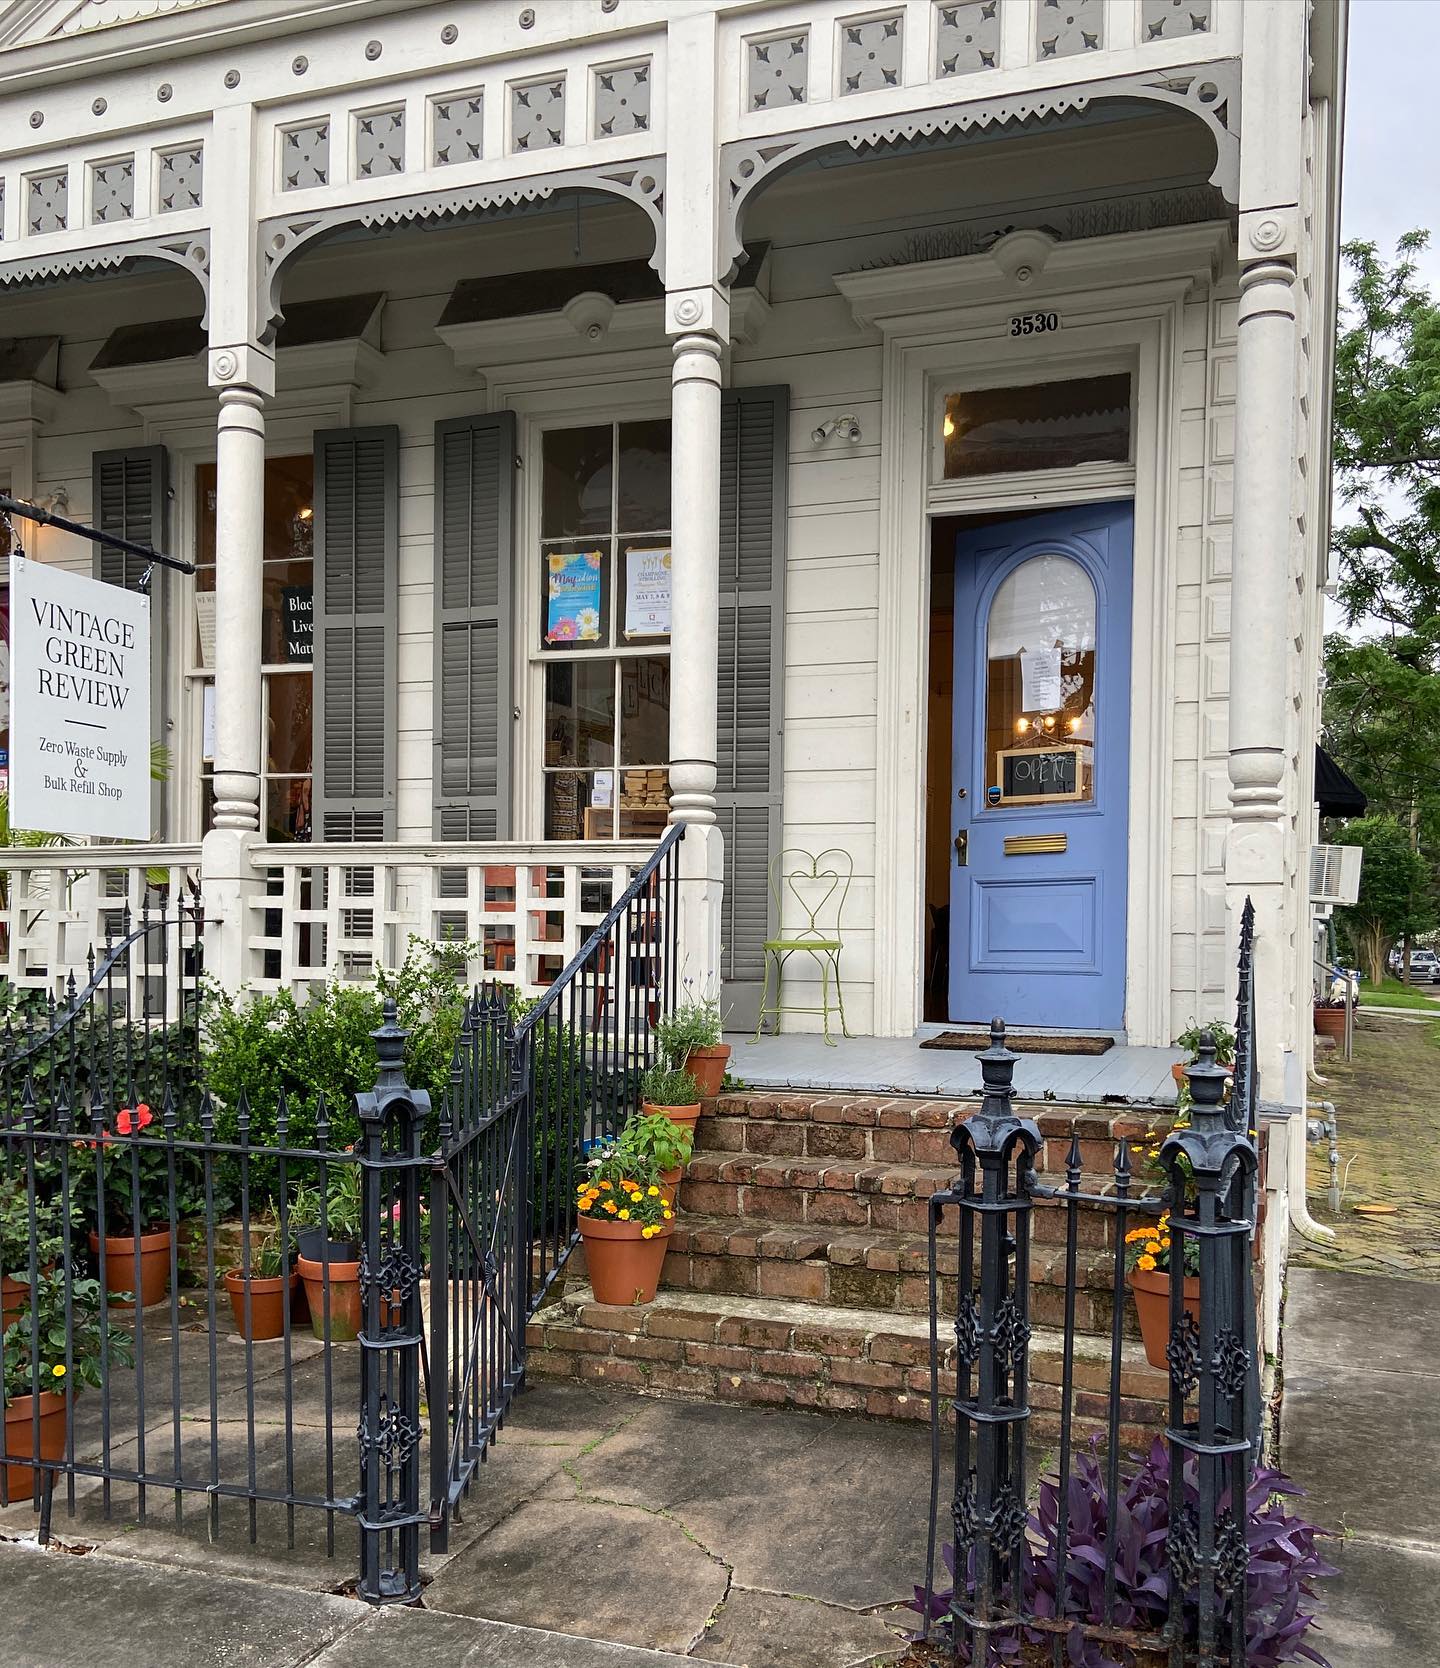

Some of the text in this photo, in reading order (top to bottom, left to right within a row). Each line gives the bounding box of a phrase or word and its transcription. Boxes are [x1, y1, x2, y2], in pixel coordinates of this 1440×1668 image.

[1011, 313, 1058, 336] 3530
[289, 595, 313, 611] Blac
[30, 597, 135, 649] VINTAGE
[292, 620, 313, 633] Live
[46, 636, 124, 679] GREEN
[289, 642, 313, 655] Matt
[38, 668, 130, 710] REVIEW
[39, 736, 128, 767] Zero Waste Supply
[74, 758, 88, 778] &
[1015, 758, 1065, 783] OPEN
[43, 775, 123, 800] Bulk Refill Shop
